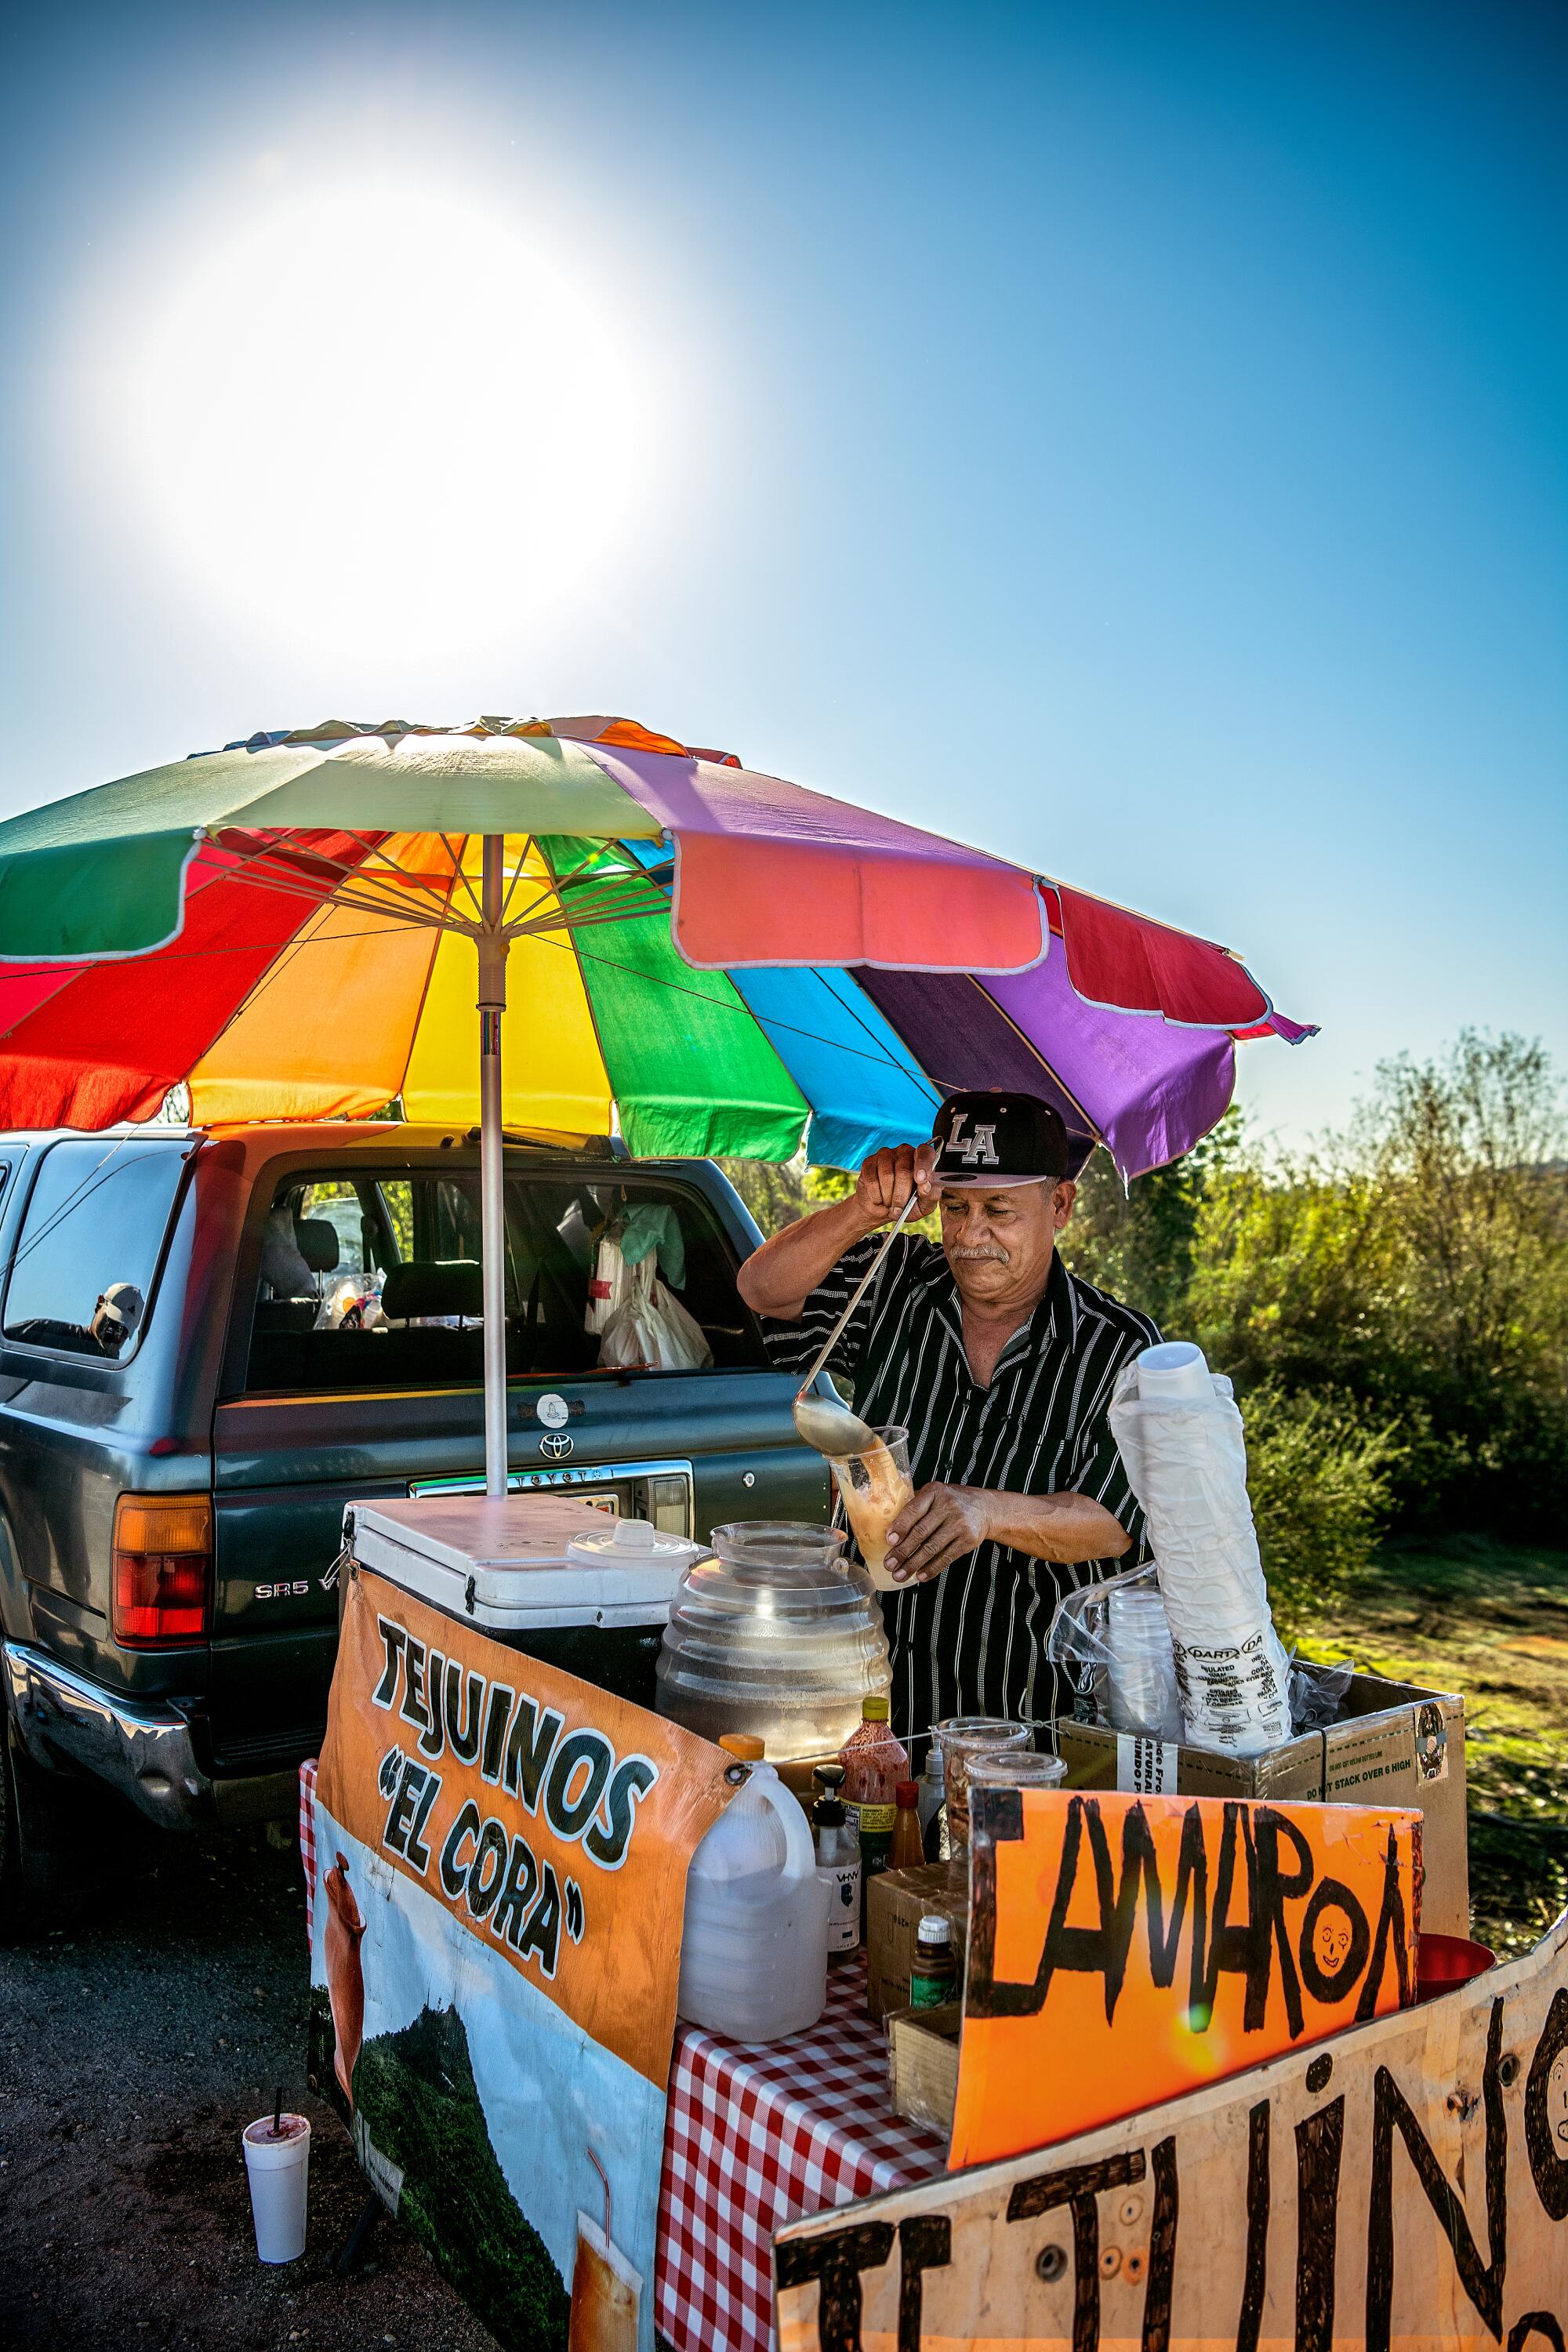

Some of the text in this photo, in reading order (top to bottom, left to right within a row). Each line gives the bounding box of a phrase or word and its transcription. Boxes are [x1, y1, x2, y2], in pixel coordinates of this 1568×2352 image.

[945, 1113, 1000, 1165] LA
[515, 1470, 603, 1487] TOYOTA
[255, 1581, 309, 1599] SR5
[1193, 1650, 1232, 1660] DART
[372, 1612, 659, 1871] TEJUINOS
[1134, 1781, 1142, 1794] P
[1307, 1788, 1316, 1800] DO
[1334, 1774, 1360, 1790] STACK
[1363, 1768, 1384, 1781] OVER
[1385, 1766, 1390, 1775] 6
[1392, 1759, 1411, 1773] HIGH
